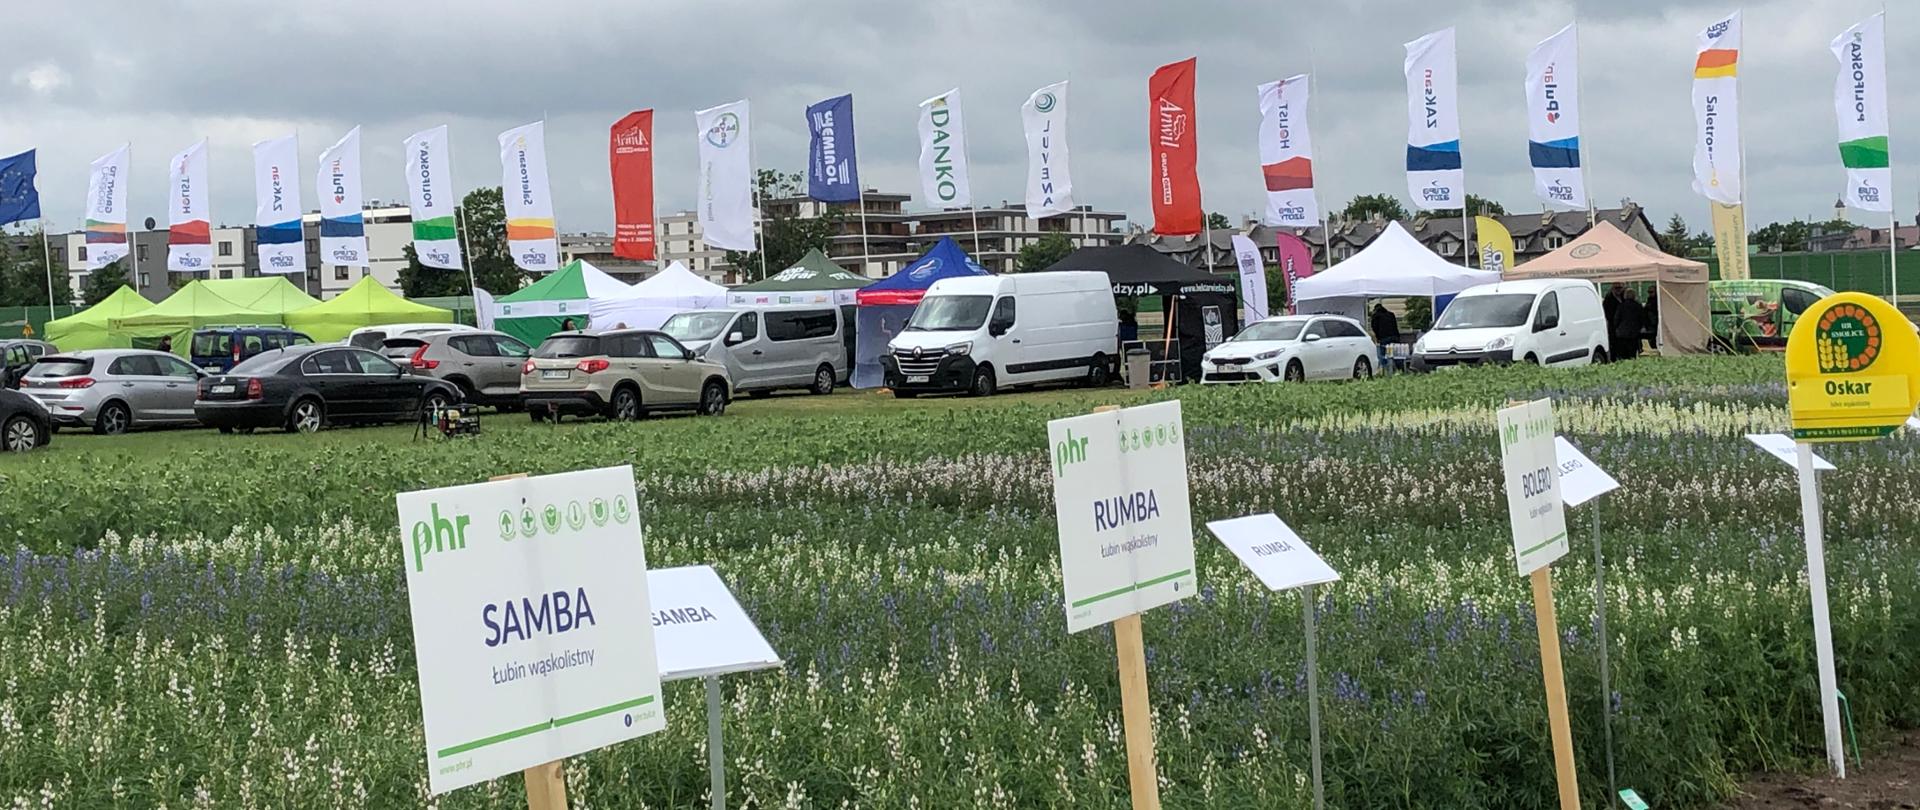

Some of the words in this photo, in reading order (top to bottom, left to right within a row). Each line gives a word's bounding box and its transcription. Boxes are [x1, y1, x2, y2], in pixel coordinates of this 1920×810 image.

[931, 109, 956, 201] DANKO
[1113, 282, 1148, 296] dzy.pl
[1825, 380, 1872, 395] Oskar
[1056, 428, 1089, 478] phr
[1522, 466, 1552, 499] BOLERO
[1094, 489, 1160, 532] RUMBA
[412, 502, 471, 572] phr
[1251, 540, 1294, 557] RUMBA
[482, 587, 596, 648] SAMBA
[651, 606, 718, 627] SAMBA
[492, 659, 527, 685] Łubin
[528, 647, 596, 678] wąskolistny
